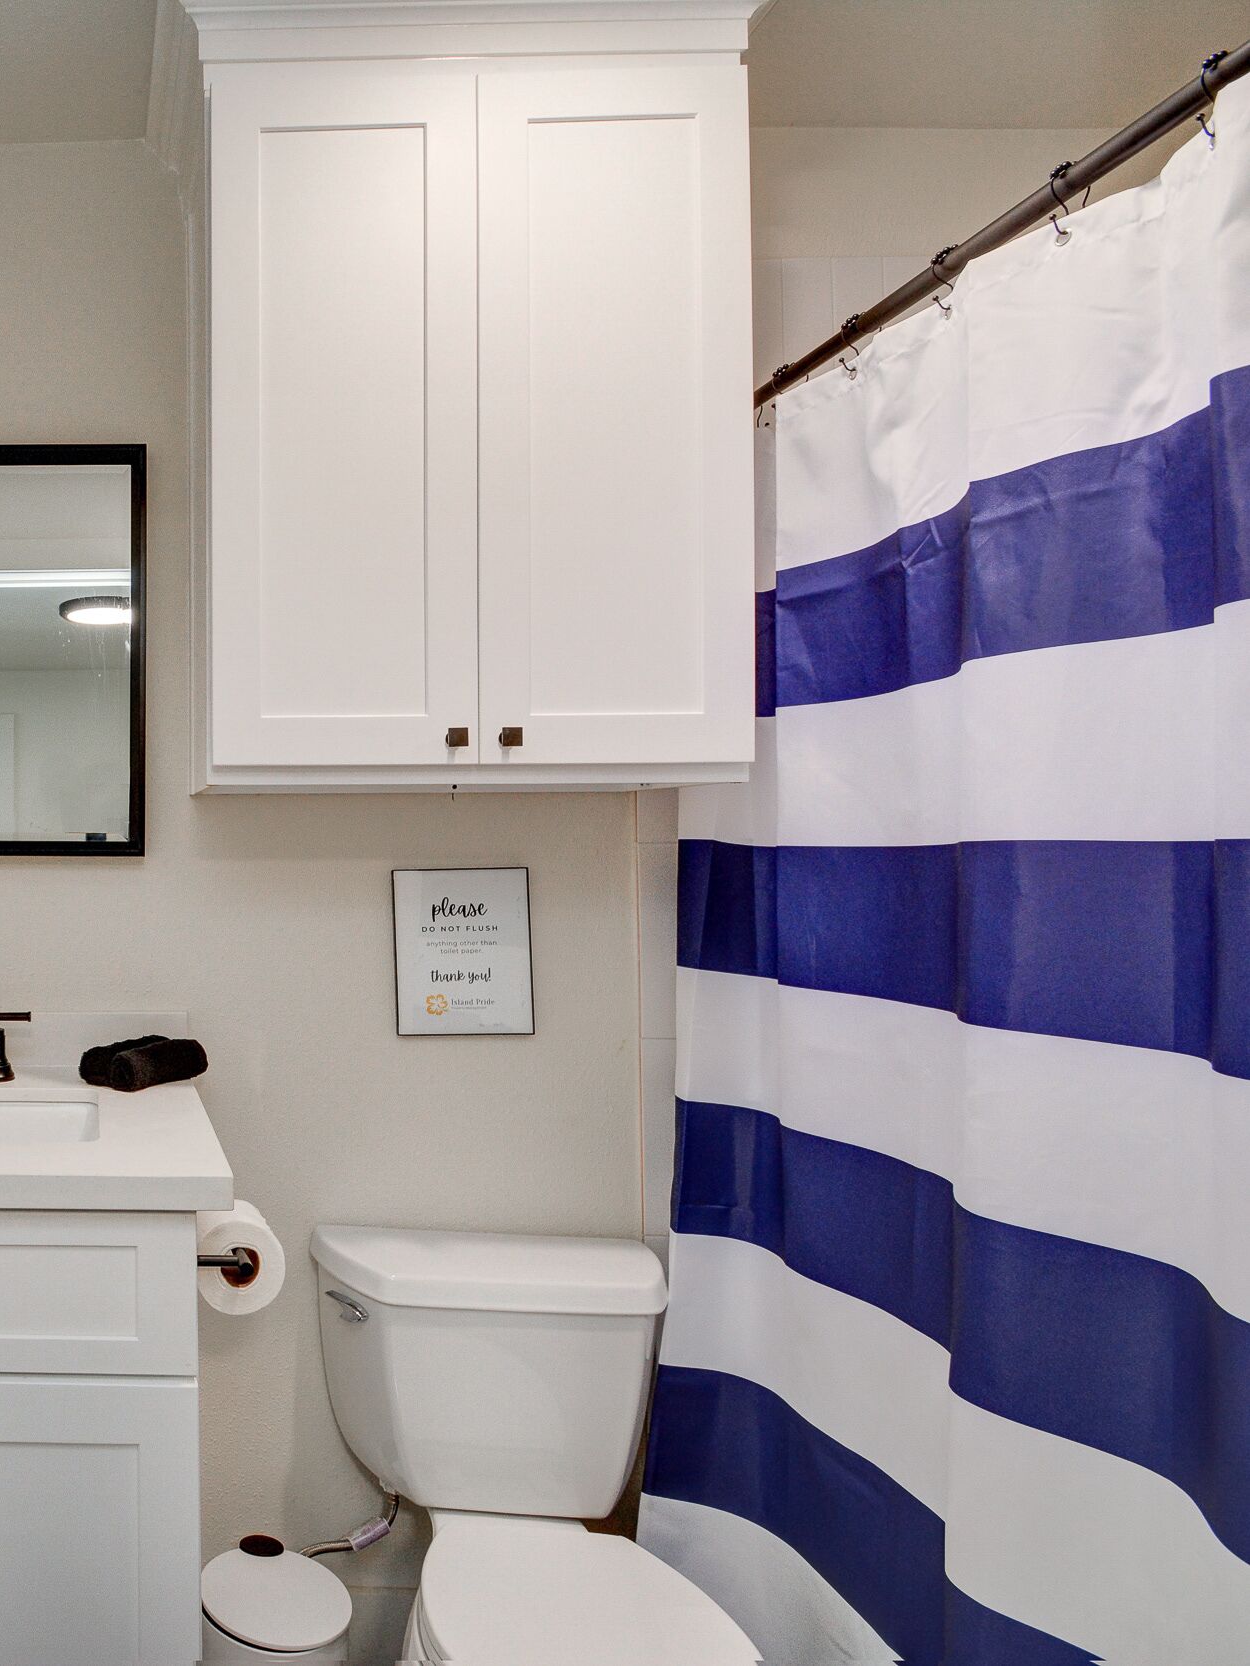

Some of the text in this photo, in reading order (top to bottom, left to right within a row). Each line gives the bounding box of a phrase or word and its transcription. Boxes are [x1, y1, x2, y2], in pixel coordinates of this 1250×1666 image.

[431, 896, 488, 923] please
[430, 967, 492, 984] thank you!
